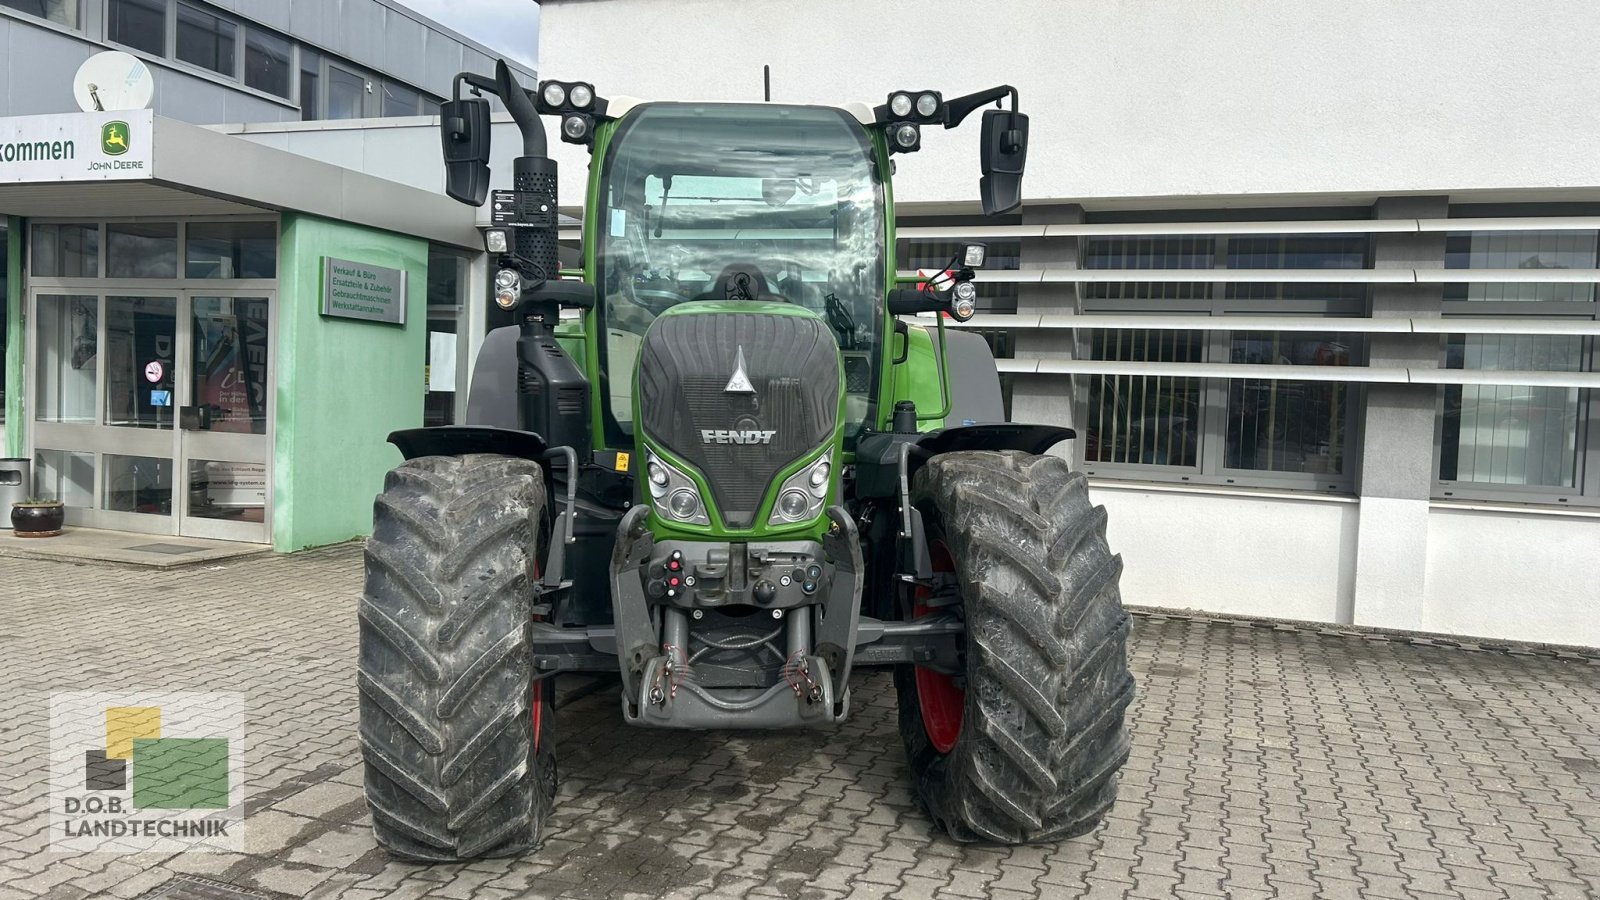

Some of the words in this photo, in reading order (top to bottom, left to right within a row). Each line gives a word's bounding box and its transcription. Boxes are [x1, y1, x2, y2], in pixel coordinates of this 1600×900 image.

[87, 161, 112, 171] JOHN
[113, 160, 143, 169] DEERE
[333, 266, 355, 277] Verkauf
[363, 270, 376, 280] Büro
[332, 278, 362, 289] Ersatzteile
[364, 282, 368, 290] &
[370, 283, 392, 293] Zubehör
[332, 289, 391, 304] Gebrauchtmaschinen
[333, 301, 384, 314] Werkstattannahme
[701, 429, 777, 445] FENDT
